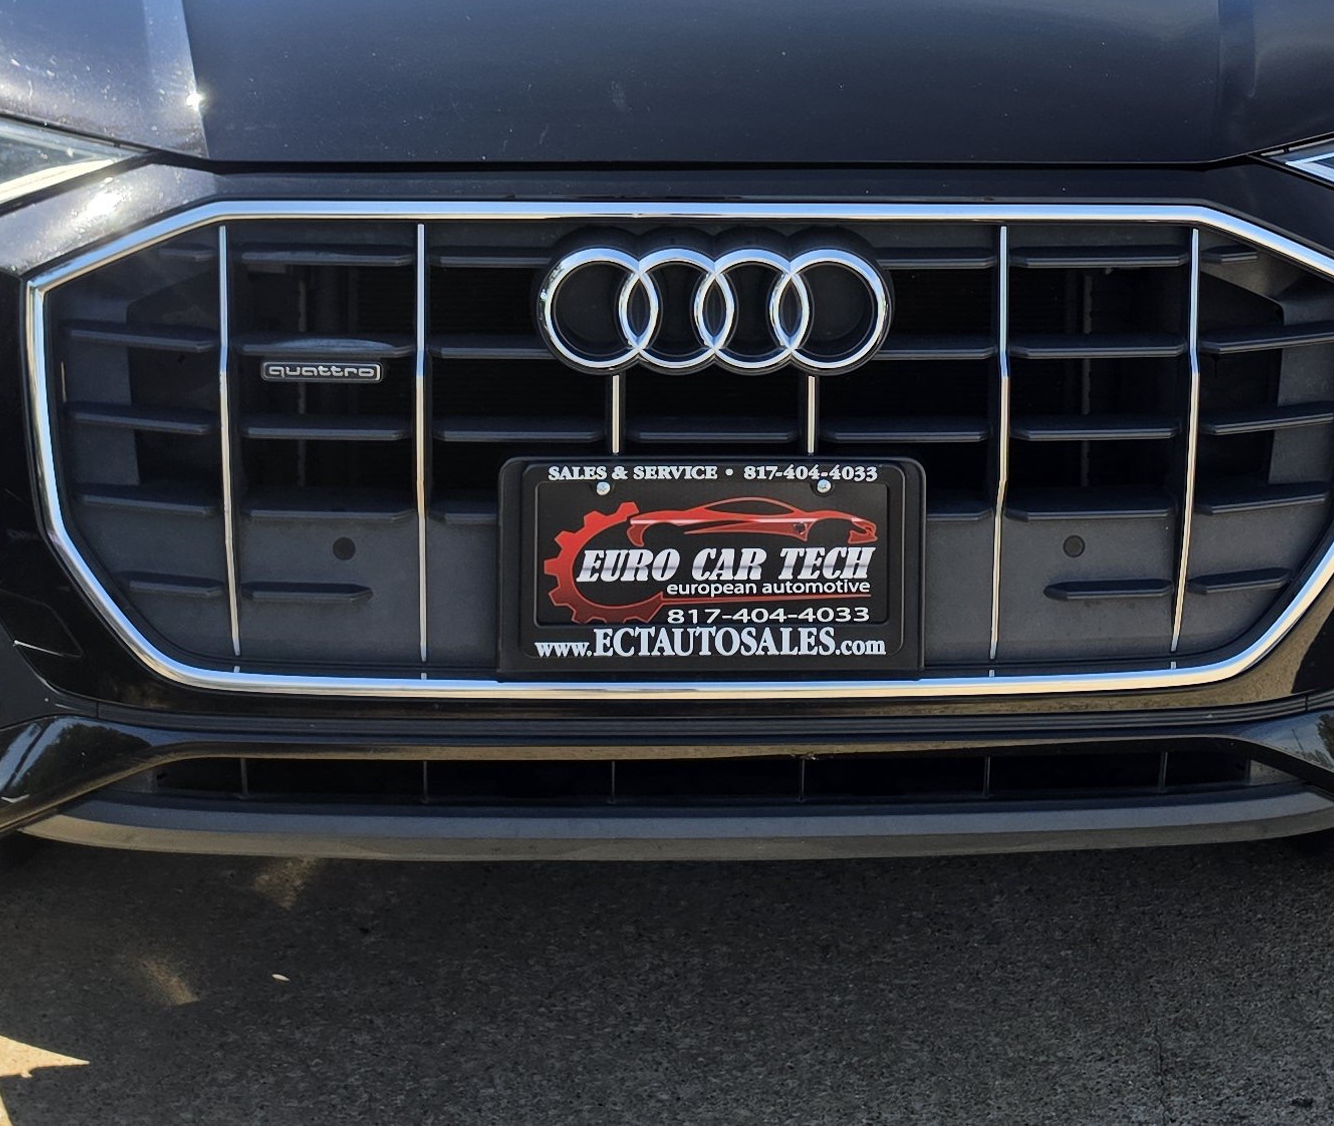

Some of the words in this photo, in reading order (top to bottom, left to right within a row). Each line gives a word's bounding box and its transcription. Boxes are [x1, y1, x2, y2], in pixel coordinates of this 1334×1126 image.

[269, 365, 375, 378] quattro
[548, 466, 609, 481] SALES
[612, 466, 629, 480] &
[634, 466, 718, 480] SERVICE
[744, 466, 878, 481] 817-404-4033
[576, 548, 682, 582] EURO
[692, 547, 767, 581] CAR
[778, 546, 876, 580] TECH
[667, 582, 757, 597] european
[762, 580, 871, 595] automotive
[667, 607, 870, 624] 817-404-4033
[534, 627, 886, 657] www.ECTAUTOSALES.com
